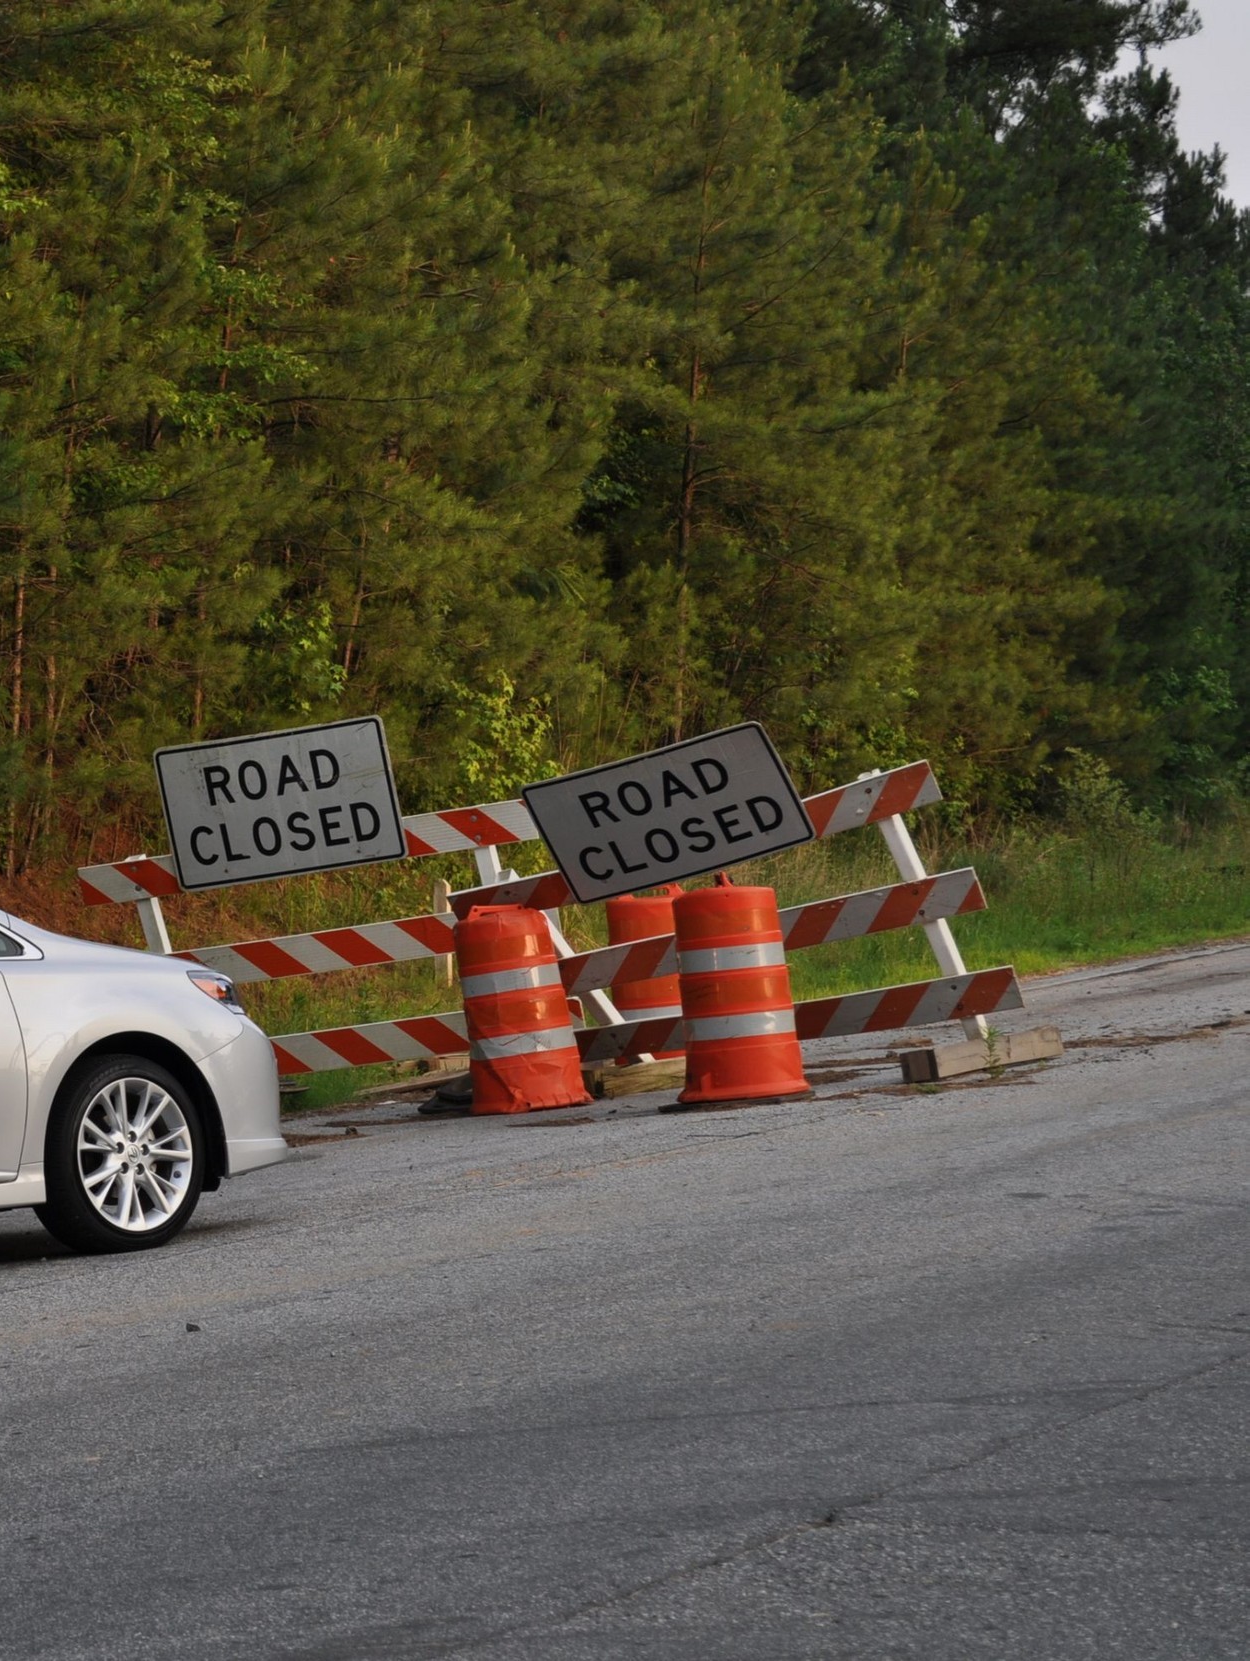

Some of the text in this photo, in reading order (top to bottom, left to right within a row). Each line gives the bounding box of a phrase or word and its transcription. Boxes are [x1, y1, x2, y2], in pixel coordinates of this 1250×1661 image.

[203, 749, 340, 806] ROAD
[578, 758, 729, 828] ROAD
[190, 802, 381, 866] CLOSED
[579, 795, 784, 881] CLOSED
